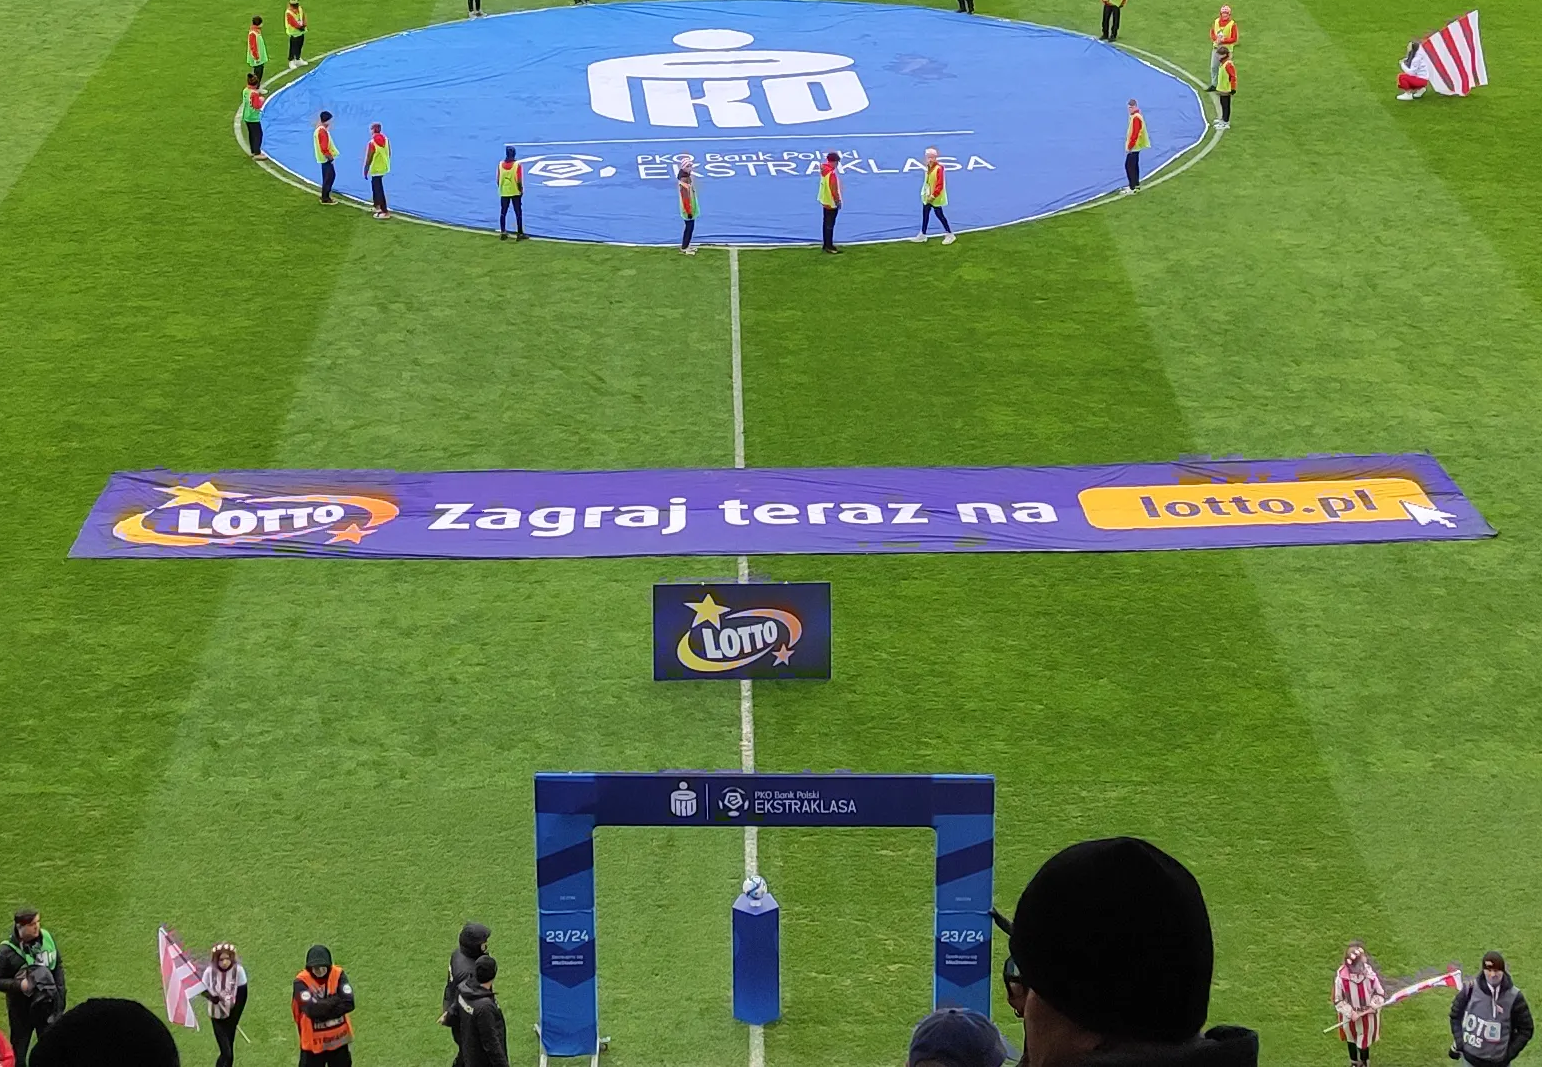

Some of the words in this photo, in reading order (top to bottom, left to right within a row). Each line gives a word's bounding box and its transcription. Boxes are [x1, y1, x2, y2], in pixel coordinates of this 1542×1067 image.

[636, 153, 695, 164] PKO
[705, 151, 774, 162] Bank
[427, 496, 687, 537] Zagraj
[717, 497, 931, 526] teraz
[956, 498, 1059, 525] na
[1138, 487, 1378, 522] lotto.pl
[176, 503, 346, 537] LOTTO
[700, 620, 780, 660] LOTTO
[754, 790, 773, 799] PKO
[774, 790, 795, 799] Bank
[796, 790, 820, 799] Polski
[754, 799, 857, 814] EKSTRAKLASA
[545, 929, 589, 943] 23/24
[940, 929, 984, 943] 23/24
